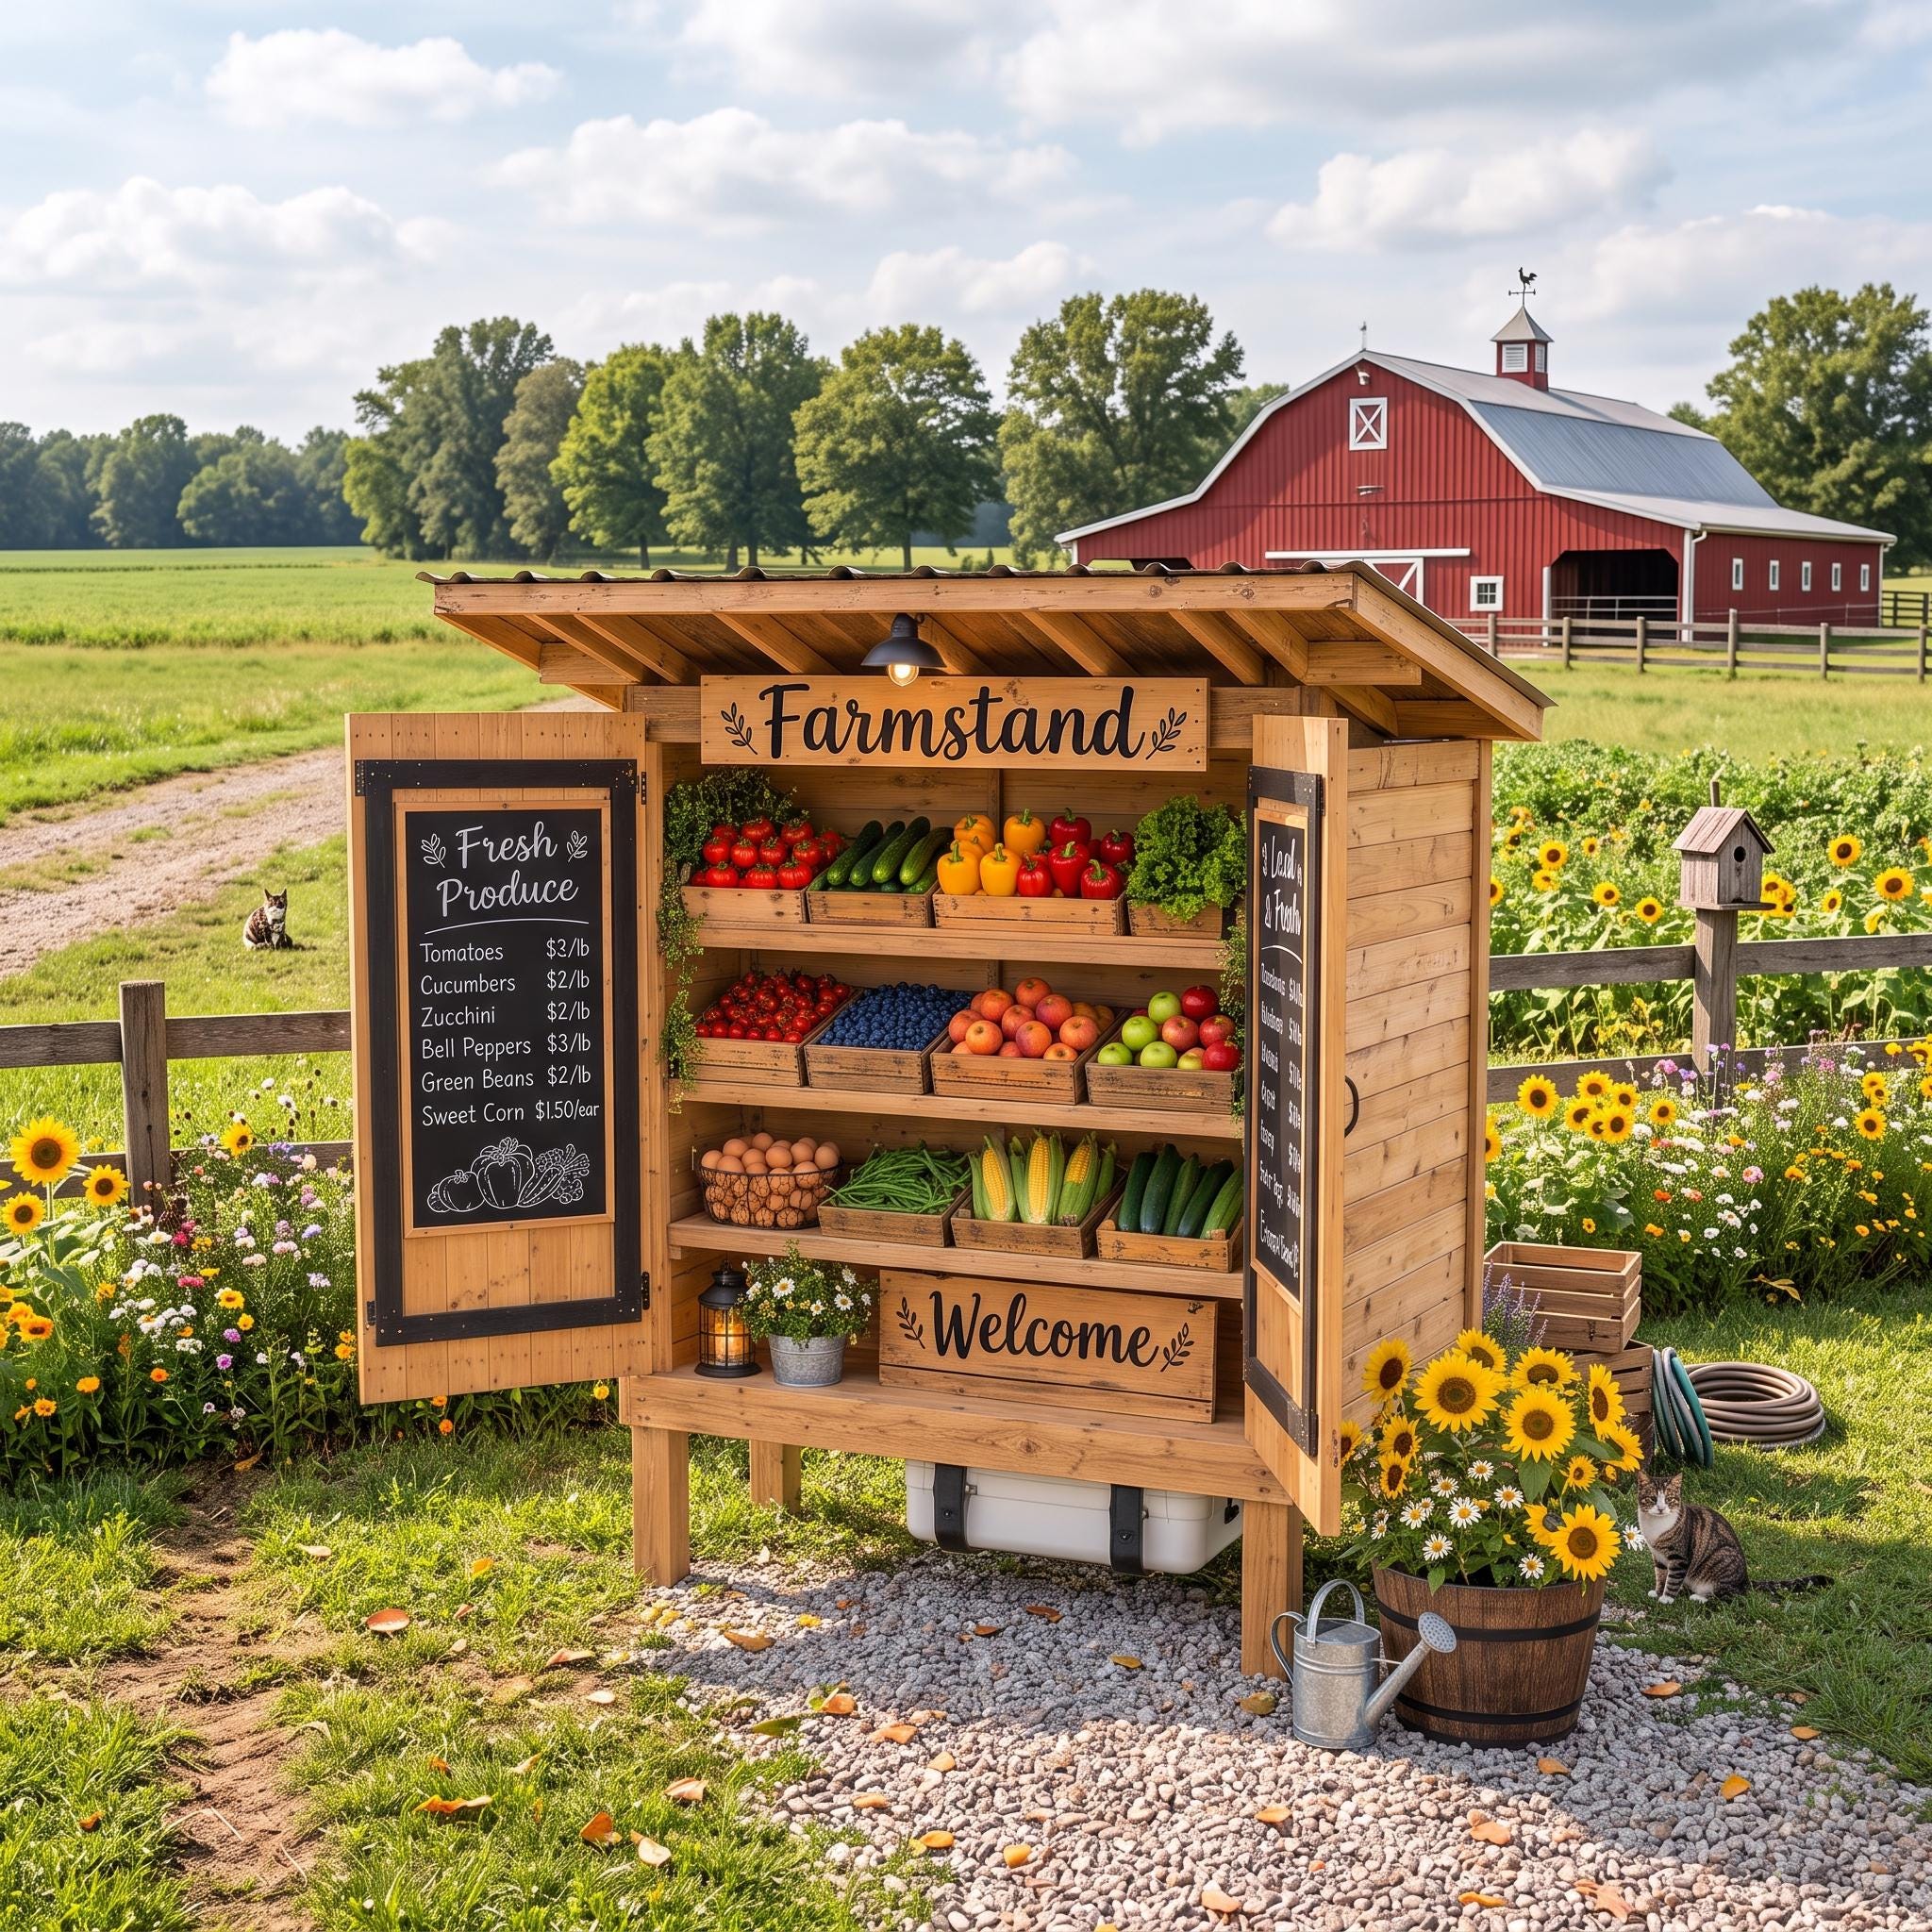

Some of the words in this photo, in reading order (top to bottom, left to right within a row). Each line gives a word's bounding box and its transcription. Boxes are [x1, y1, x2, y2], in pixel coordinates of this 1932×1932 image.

[759, 684, 1145, 760] Farmstand
[456, 822, 558, 868] Fresh
[437, 870, 578, 917] Produce
[420, 943, 503, 962] Tomatoes
[547, 938, 589, 959] $3/lb
[421, 974, 515, 994] Cucumbers
[547, 969, 589, 991] $2/lb
[422, 1006, 494, 1026] Zucchini
[548, 1001, 590, 1023] $2/lb
[423, 1039, 454, 1058] Bell
[464, 1038, 530, 1061] Peppers
[548, 1033, 591, 1054] $3/lb
[422, 1072, 473, 1092] Green
[483, 1069, 533, 1088] Beans
[548, 1065, 591, 1086] $2/lb
[423, 1106, 475, 1125] Sweet
[484, 1103, 524, 1122] Corn
[536, 1099, 599, 1121] $1.50/ear
[929, 1290, 1159, 1367] Welcome
